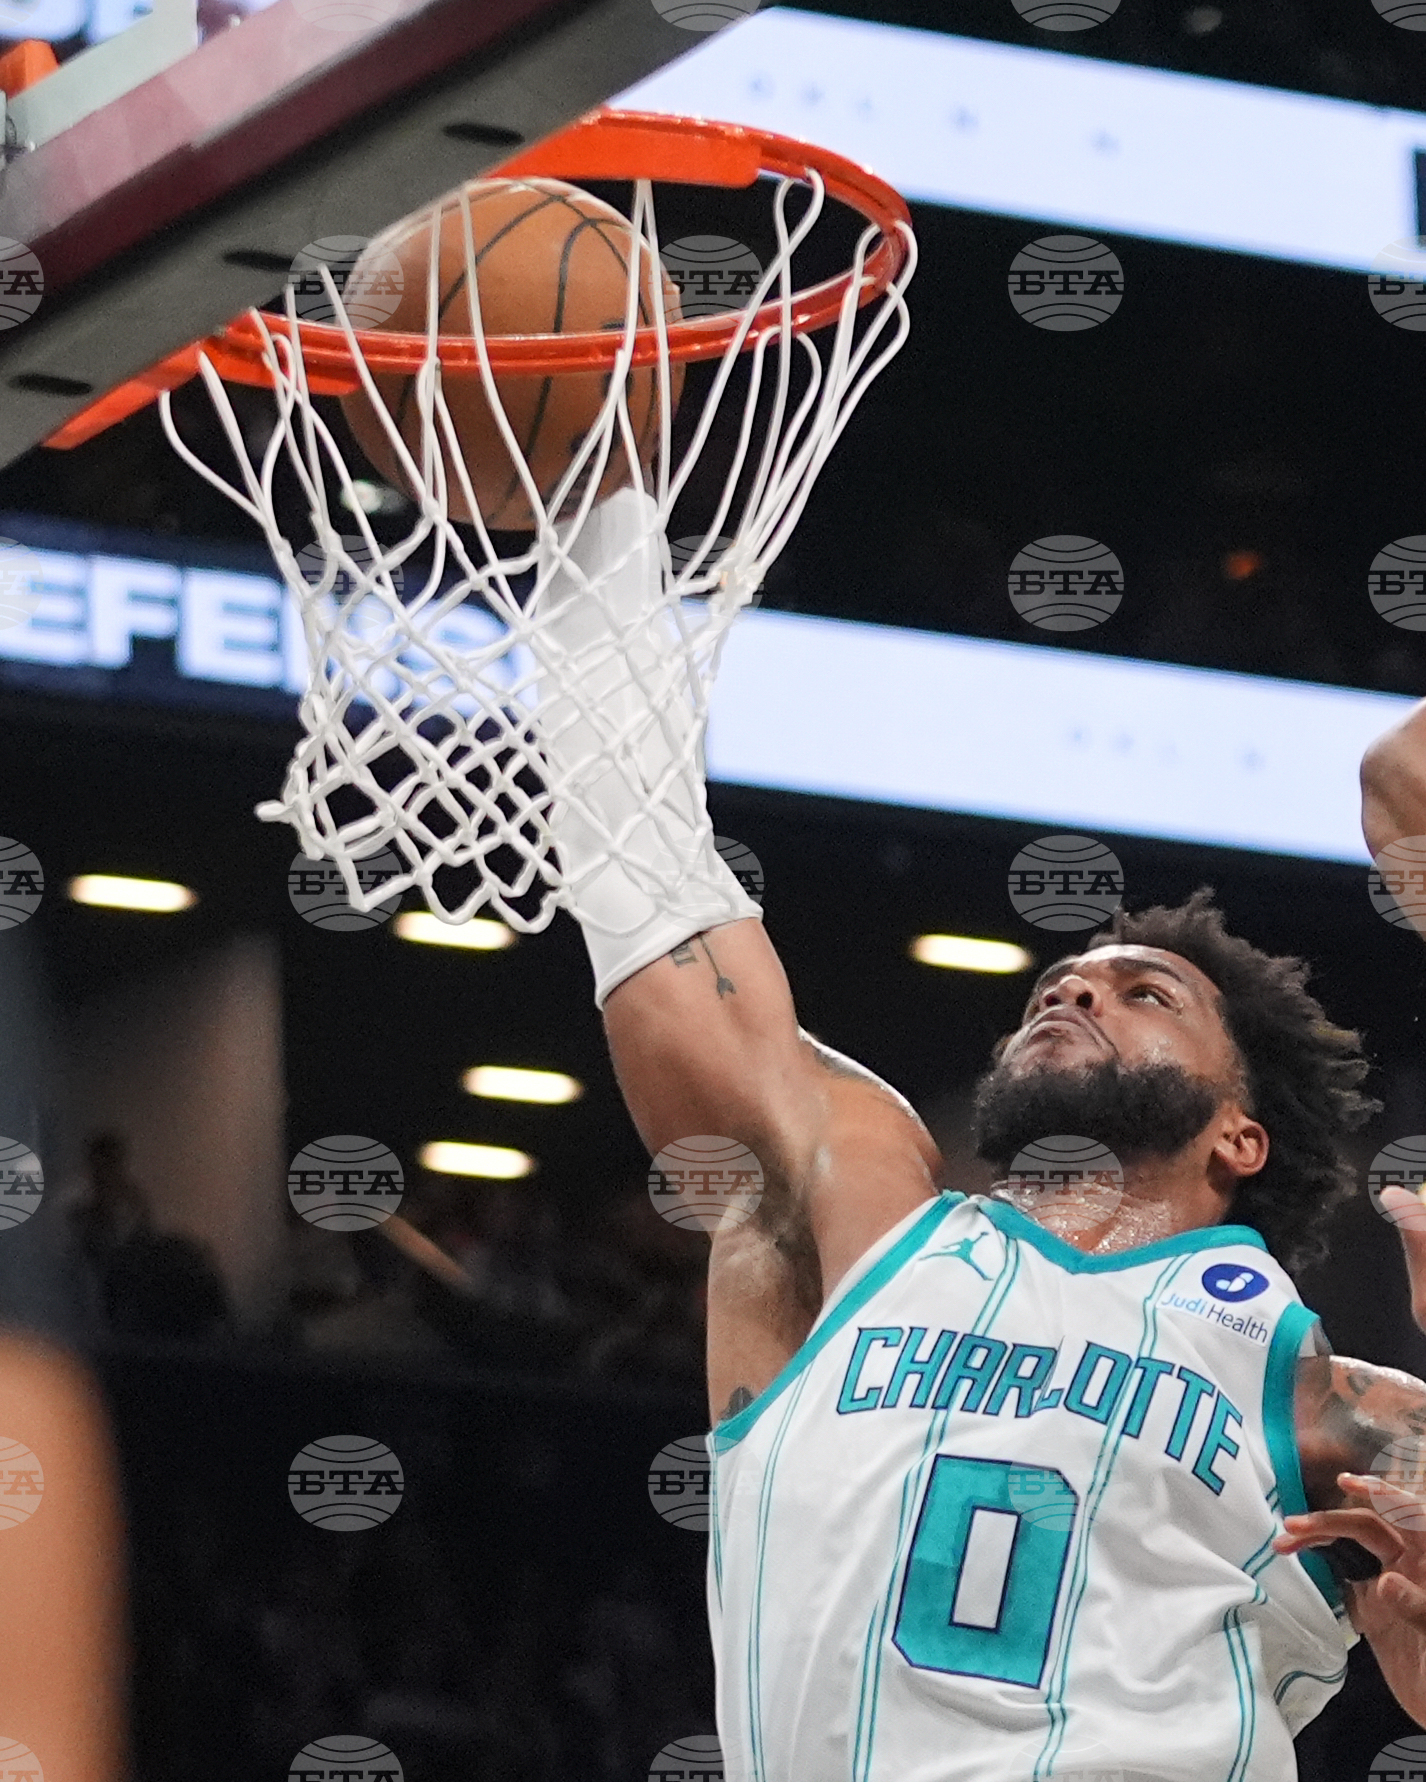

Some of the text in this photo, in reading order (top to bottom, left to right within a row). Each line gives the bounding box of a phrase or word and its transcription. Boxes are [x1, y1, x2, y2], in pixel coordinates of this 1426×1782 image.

[1161, 1293, 1268, 1343] Judi Health
[891, 1453, 1080, 1689] 0
